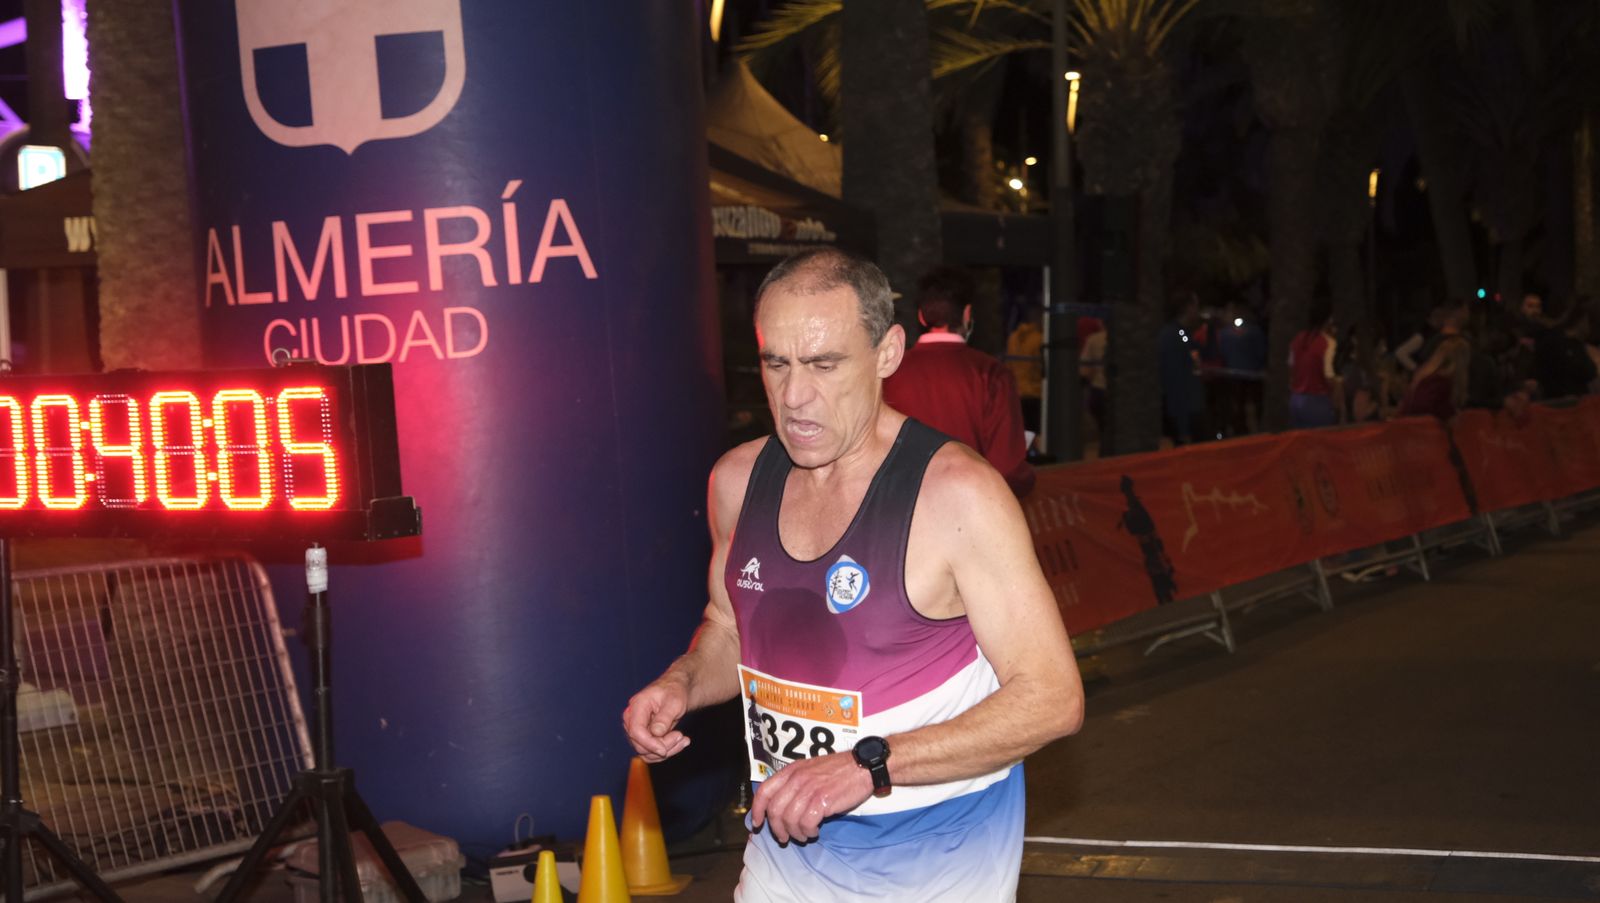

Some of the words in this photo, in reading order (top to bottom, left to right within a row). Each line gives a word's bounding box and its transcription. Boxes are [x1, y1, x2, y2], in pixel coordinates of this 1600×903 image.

[206, 179, 598, 307] ALMERÍA
[263, 306, 489, 367] CIUDAD
[761, 712, 836, 759] 328
